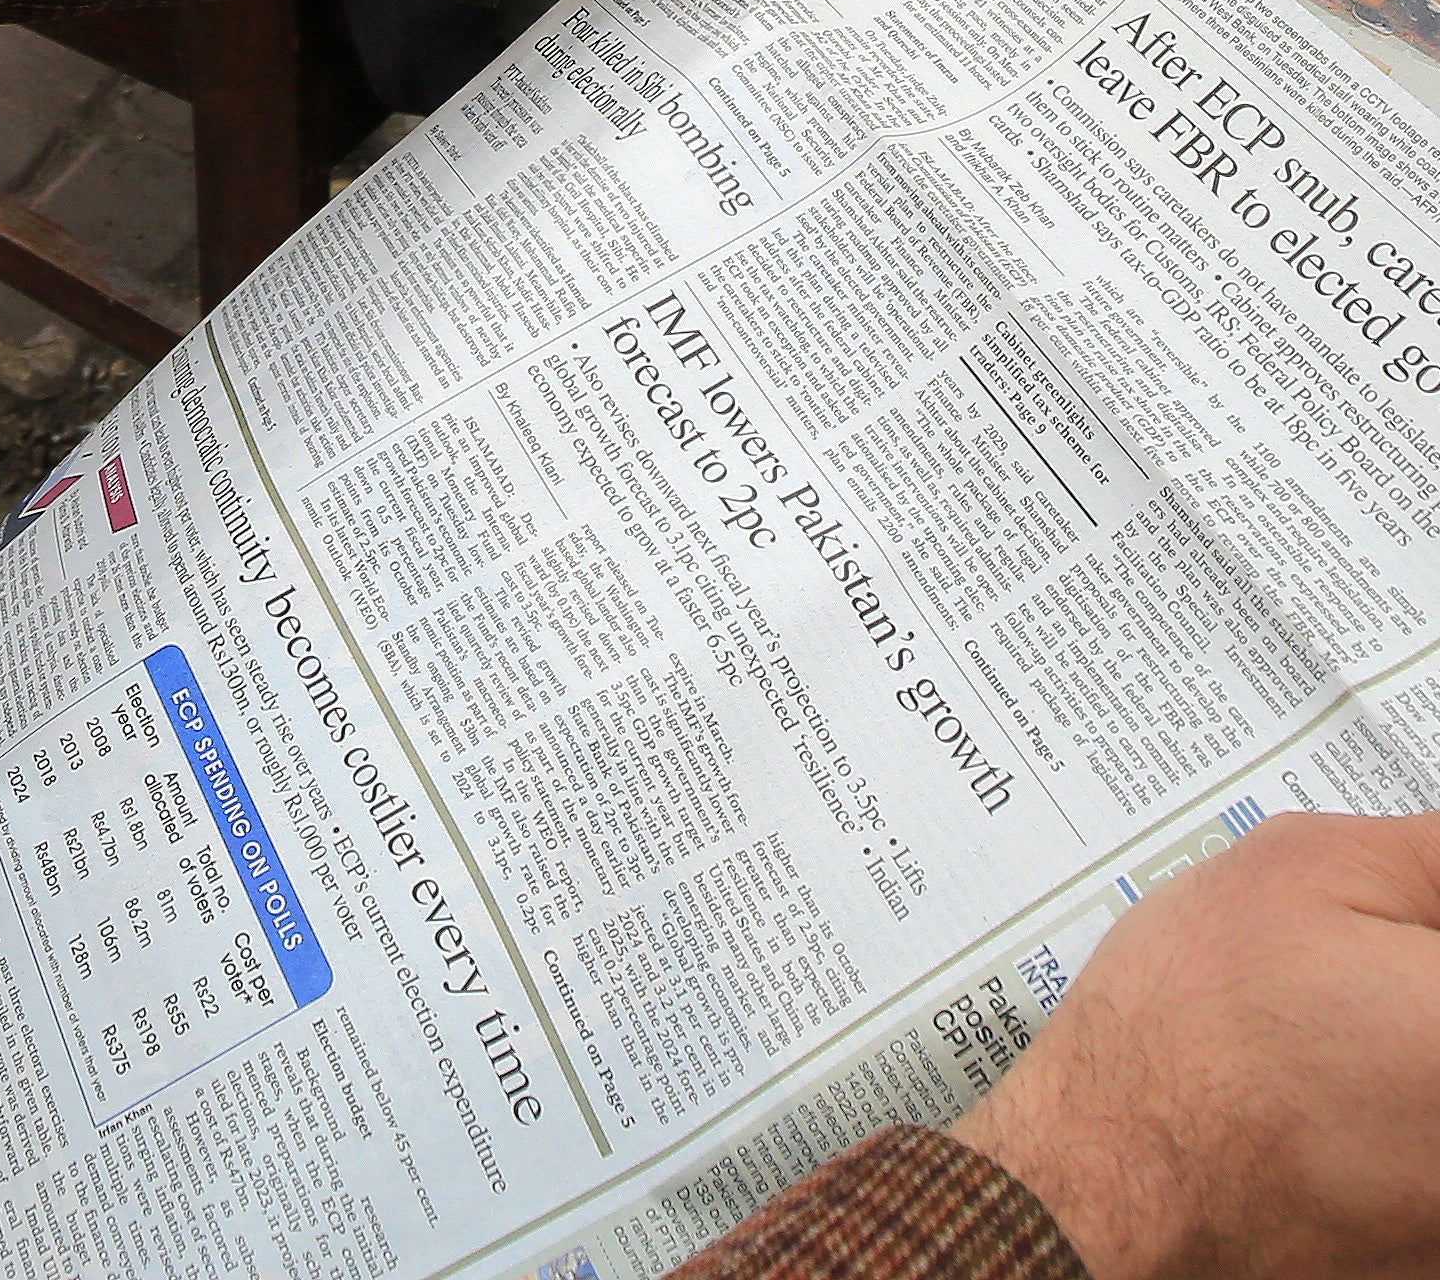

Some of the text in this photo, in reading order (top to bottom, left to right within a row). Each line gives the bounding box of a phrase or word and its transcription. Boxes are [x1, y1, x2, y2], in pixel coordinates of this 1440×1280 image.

[1110, 12, 1203, 91] After
[1192, 75, 1286, 156] ECP
[1271, 157, 1360, 247] snub,
[1072, 36, 1156, 121] leave
[1147, 106, 1238, 198] FBR
[1229, 187, 1271, 229] to
[1268, 228, 1406, 348] elected
[968, 343, 1047, 435] traders: Page 9
[980, 332, 1110, 485] simplified tax scheme for
[994, 319, 1095, 441] Cabinet greenlights
[601, 315, 777, 549] forecast to 2pc
[642, 288, 1015, 816] IMF lowers Pakistan's growth
[84, 715, 112, 758] 2008
[109, 702, 137, 741] year
[124, 681, 160, 749] Election
[32, 748, 57, 787] 2018
[58, 731, 84, 771] 2013
[180, 389, 542, 1126] democratic continuity becomes costlier every time
[5, 764, 31, 804] 2024
[143, 772, 185, 845] allocated
[161, 771, 198, 828] Amount
[89, 809, 120, 868] Rs4.7bn
[117, 795, 148, 852] Rs1.8bn
[170, 686, 302, 950] ECP SPENDING ON POLLS
[32, 840, 62, 898] Rs48bn
[61, 826, 90, 881] Rs21bn
[195, 843, 230, 914] Total no.
[155, 887, 178, 924] 81m
[177, 856, 215, 925] of voters
[96, 914, 122, 964] 106m
[123, 896, 152, 949] 86.2m
[67, 932, 92, 980] 128m
[233, 931, 275, 1007] Cost per
[161, 991, 190, 1036] Rs55
[191, 974, 220, 1019] Rs22
[100, 1022, 132, 1076] Rs375
[130, 1005, 161, 1057] Rs198
